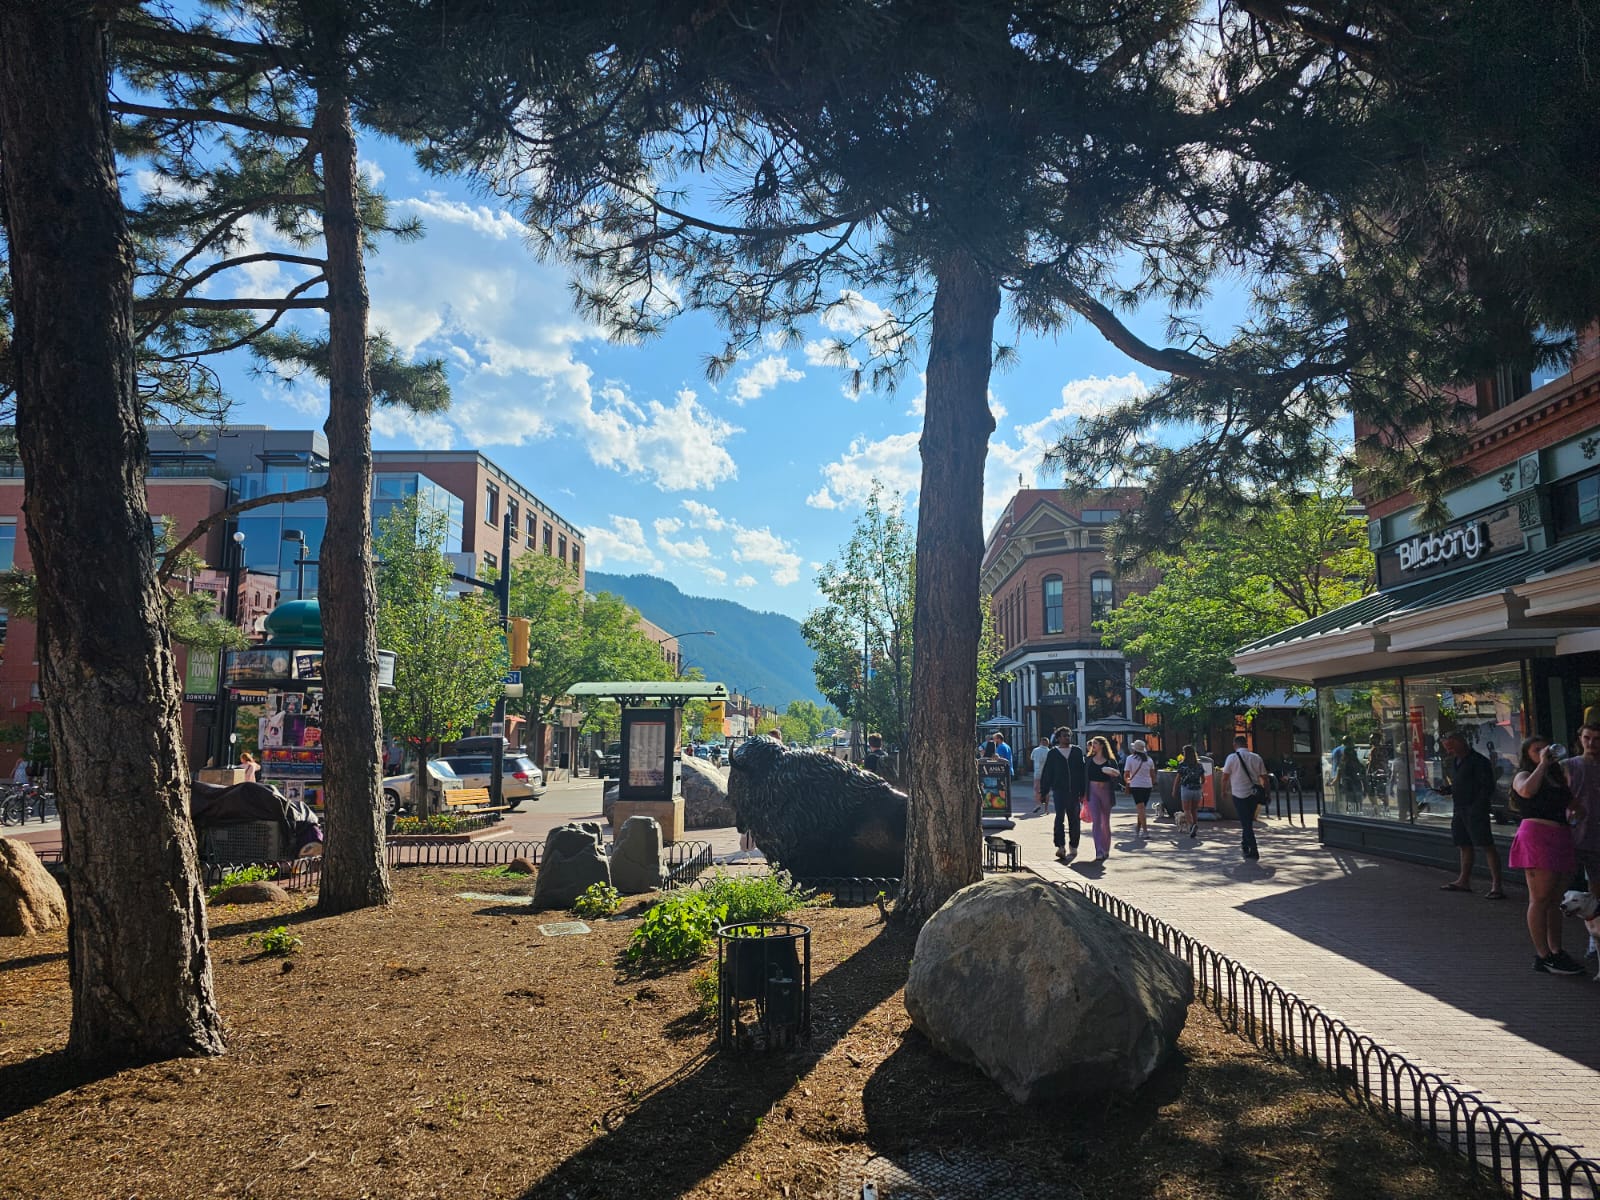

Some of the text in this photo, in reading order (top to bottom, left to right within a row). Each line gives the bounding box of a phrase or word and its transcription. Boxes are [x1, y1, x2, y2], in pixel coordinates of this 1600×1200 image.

[1400, 525, 1479, 570] Billabong
[191, 662, 214, 679] TOWN
[1048, 682, 1073, 696] SALT
